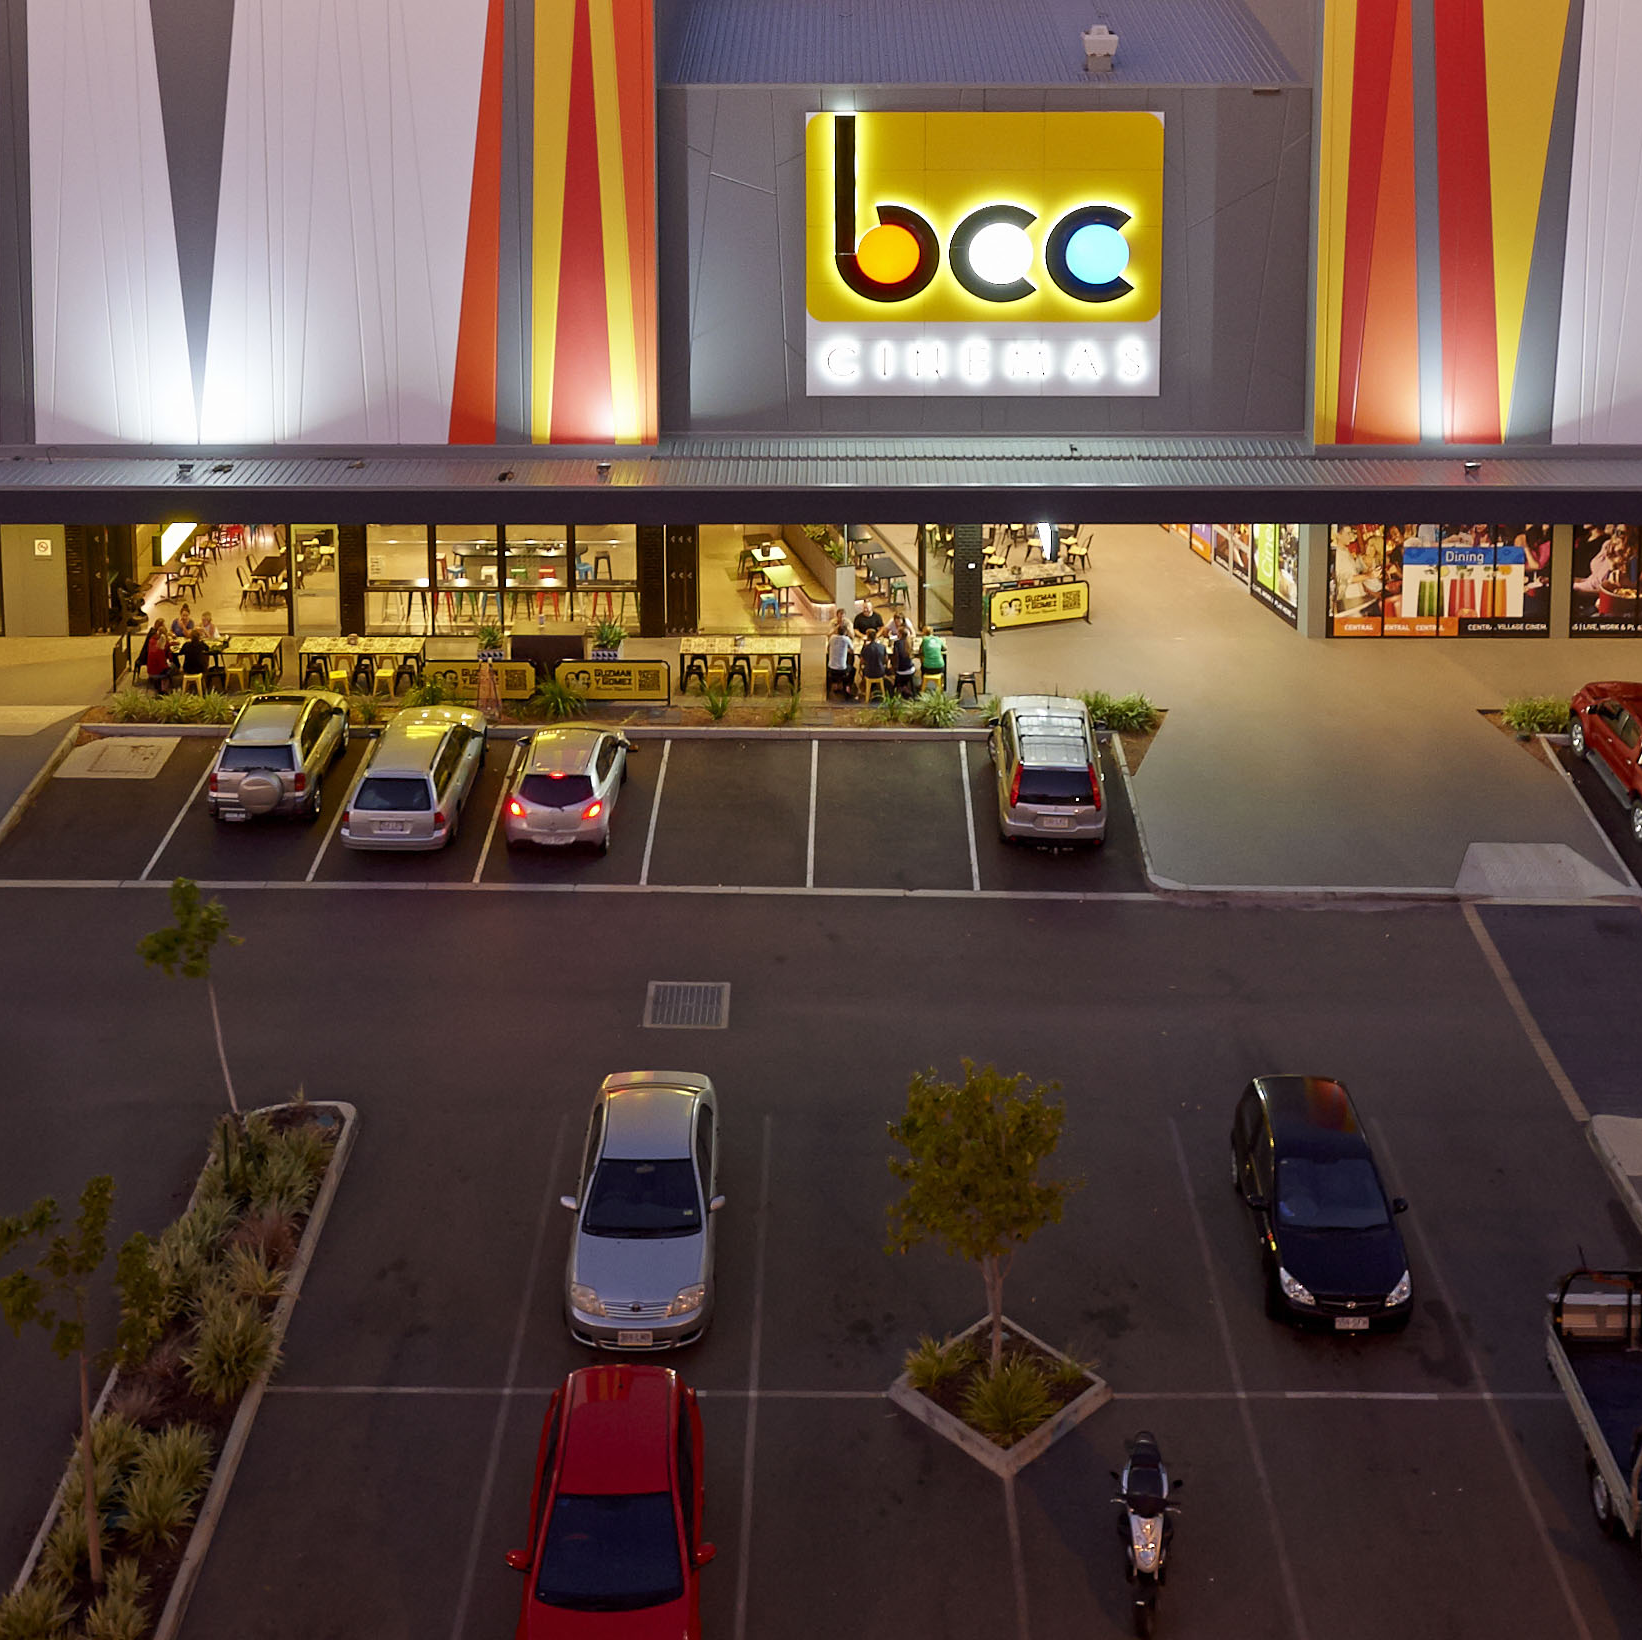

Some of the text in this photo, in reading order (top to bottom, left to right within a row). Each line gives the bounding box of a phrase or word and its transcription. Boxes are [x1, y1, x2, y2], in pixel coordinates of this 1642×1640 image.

[834, 115, 1134, 303] bcc
[824, 344, 1145, 379] CINEMAS
[1445, 550, 1485, 564] Dining
[1025, 593, 1057, 603] GUZMAN
[1031, 600, 1057, 609] GOMEZ
[1600, 623, 1619, 631] WORK
[594, 668, 632, 677] GUZMAN
[602, 677, 632, 686] GOMEZ
